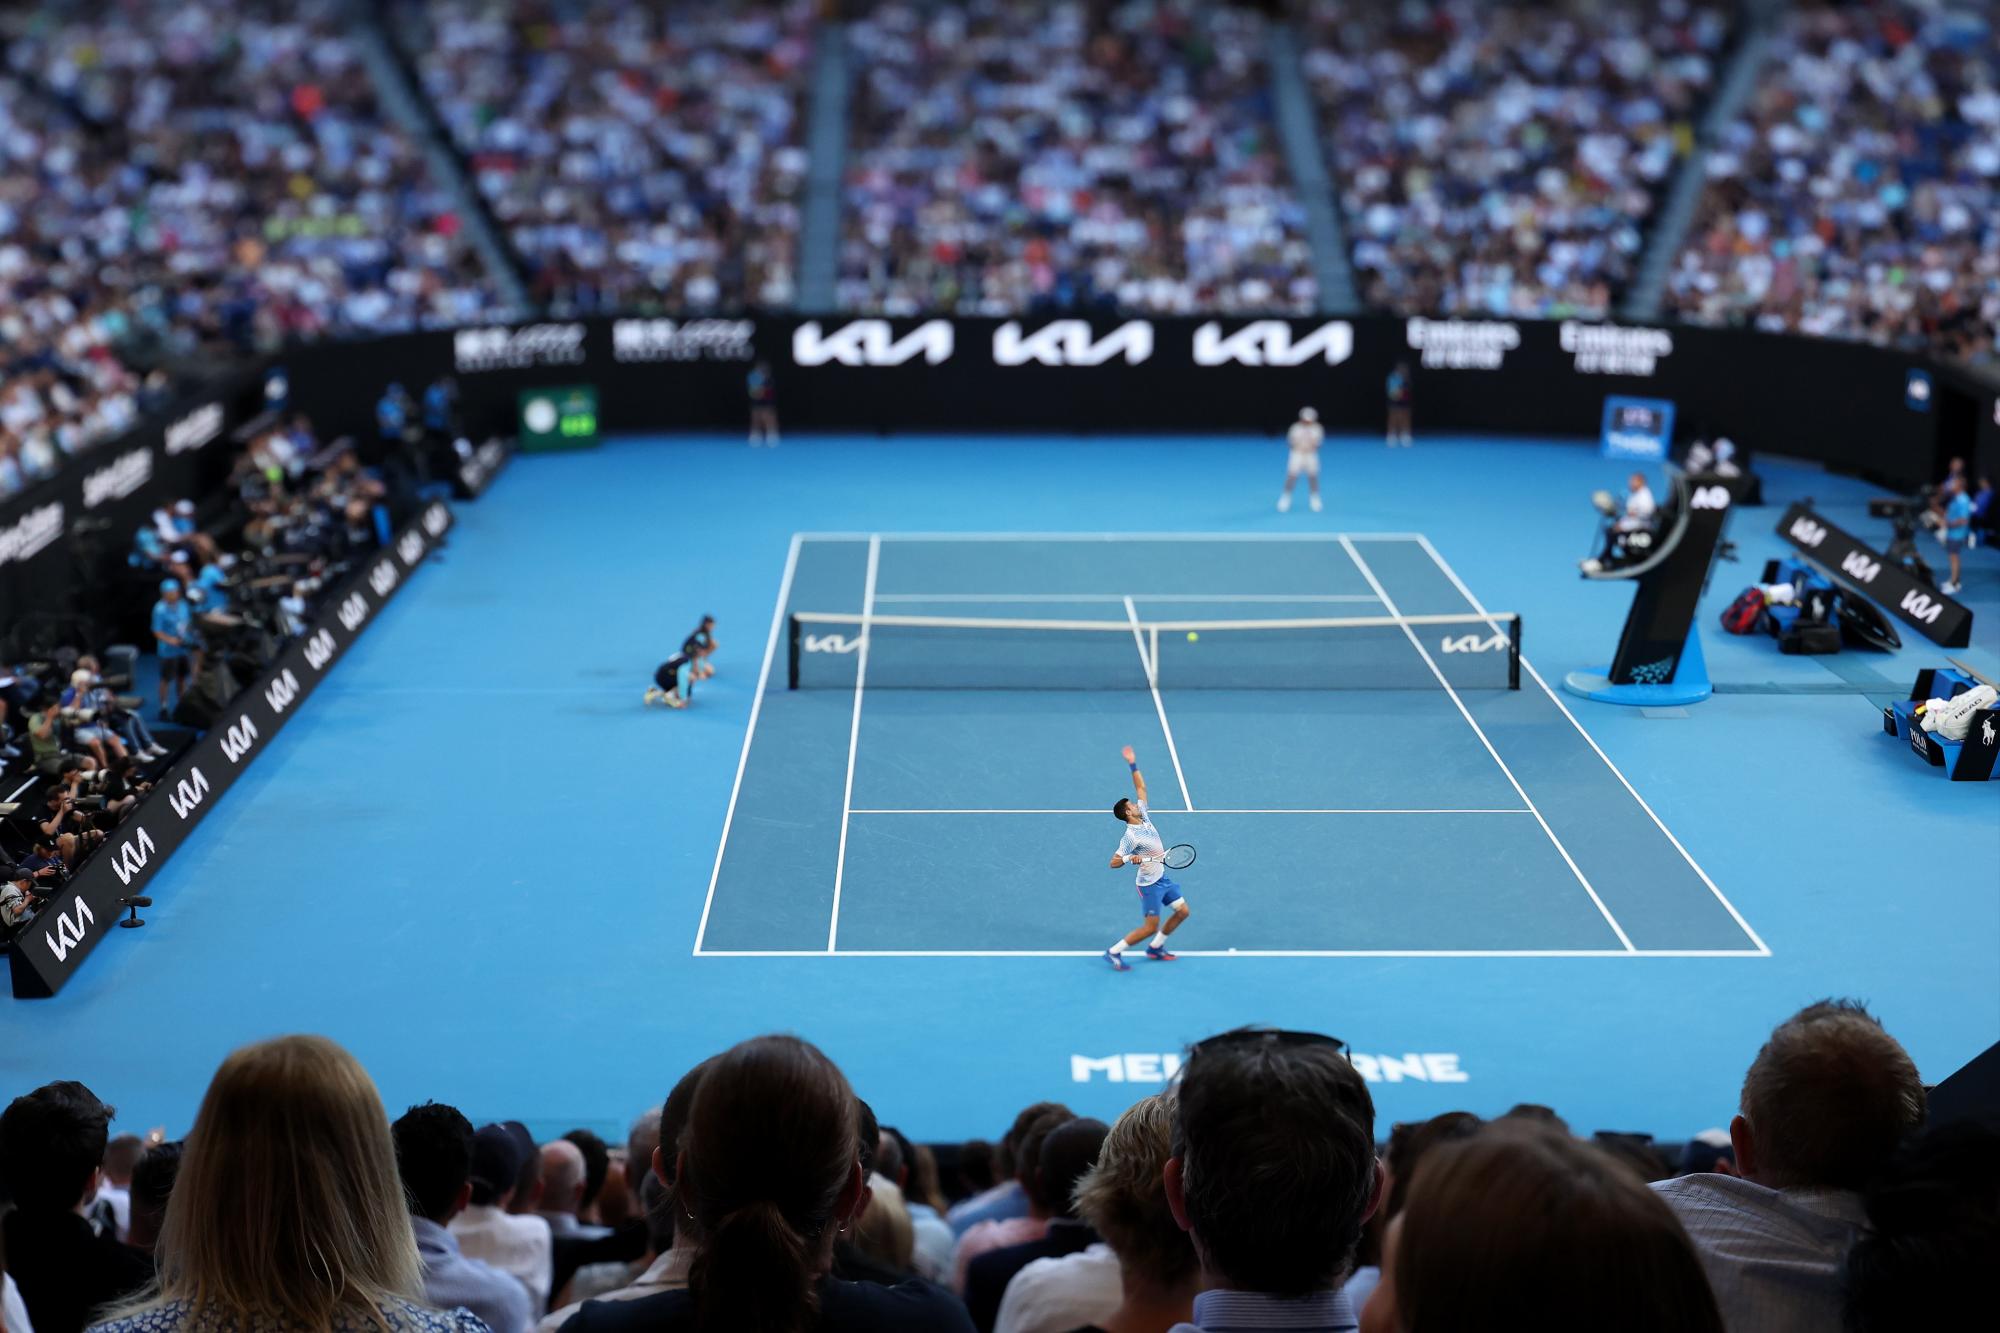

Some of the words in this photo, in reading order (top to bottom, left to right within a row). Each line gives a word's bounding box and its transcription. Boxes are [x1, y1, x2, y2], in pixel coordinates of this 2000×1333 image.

[793, 320, 954, 366] KIA
[992, 320, 1153, 366] KIA
[1192, 320, 1353, 366] KIA
[1900, 588, 1943, 624] KIA
[219, 713, 259, 763] KIA
[168, 766, 210, 820] KIA
[110, 826, 156, 886] KIA
[45, 895, 95, 963] KIA
